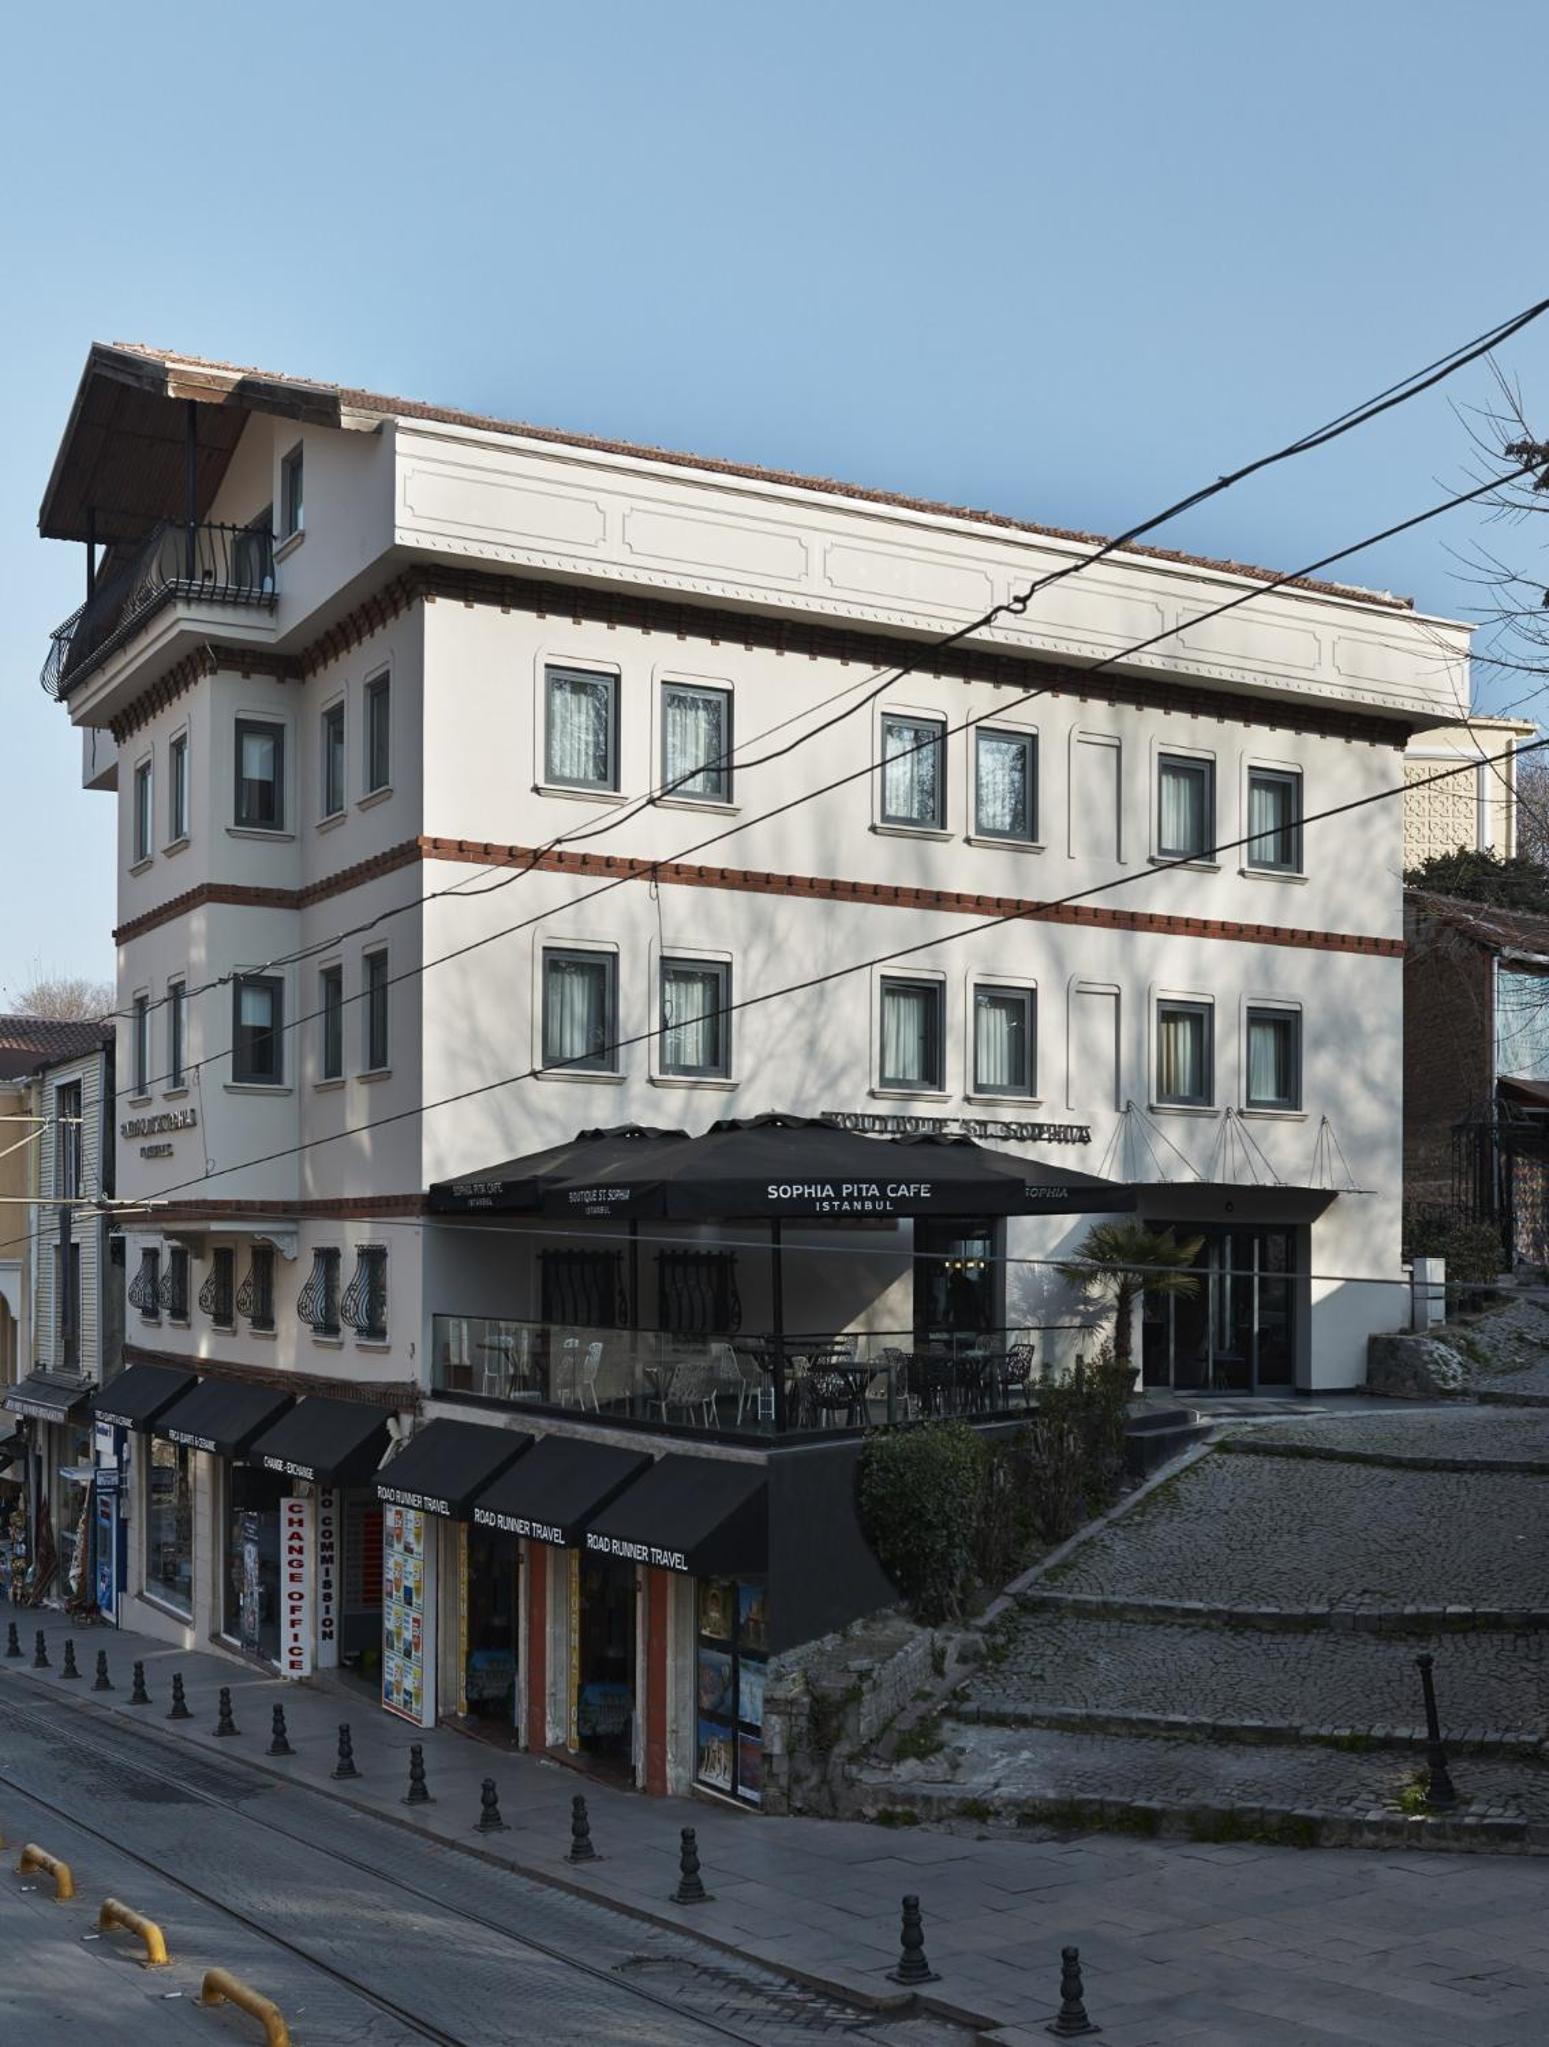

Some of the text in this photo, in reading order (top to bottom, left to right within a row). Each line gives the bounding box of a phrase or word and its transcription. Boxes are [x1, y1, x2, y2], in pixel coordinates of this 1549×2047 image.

[767, 1183, 932, 1199] SOPHIA PITA CAFE
[816, 1201, 894, 1211] ISTANBUL
[263, 1455, 284, 1472] CHANGE
[377, 1485, 451, 1516] ROAD RUNNER TRAVEL
[474, 1508, 566, 1544] ROAD RUNNER TRAVEL
[586, 1533, 689, 1571] ROAD RUNNER TRAVEL
[287, 1503, 304, 1670] CHANGE OFFICE
[320, 1516, 334, 1641] COMMISSION
